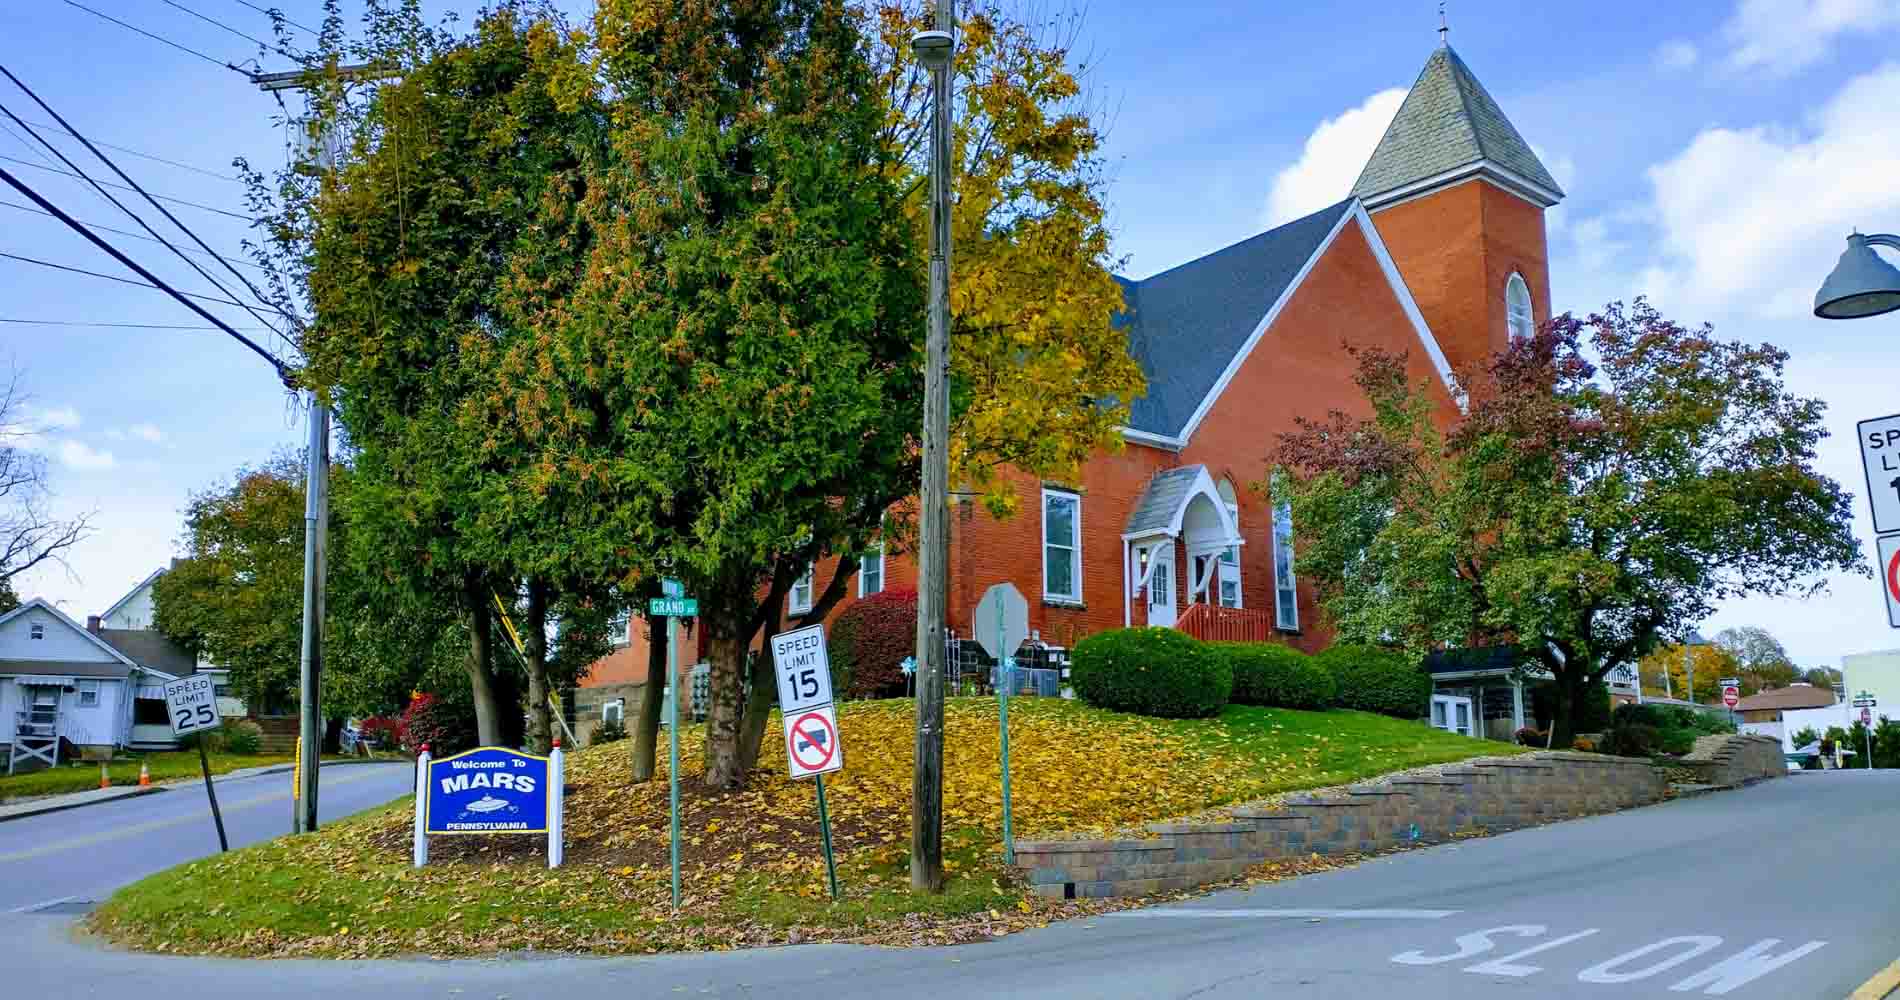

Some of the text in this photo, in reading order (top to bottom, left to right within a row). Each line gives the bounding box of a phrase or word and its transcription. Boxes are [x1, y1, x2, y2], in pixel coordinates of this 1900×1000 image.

[652, 600, 684, 613] GRAND
[778, 635, 819, 655] SPEED
[784, 652, 816, 670] LIMIT
[168, 680, 208, 696] SPEED
[788, 669, 819, 701] 15
[175, 691, 206, 706] LIMIT
[175, 704, 214, 729] 25
[451, 759, 526, 769] Welcome To
[440, 772, 536, 794] MARS
[446, 822, 528, 830] PENNSYLVANIA
[1390, 924, 1830, 995] SLOW
